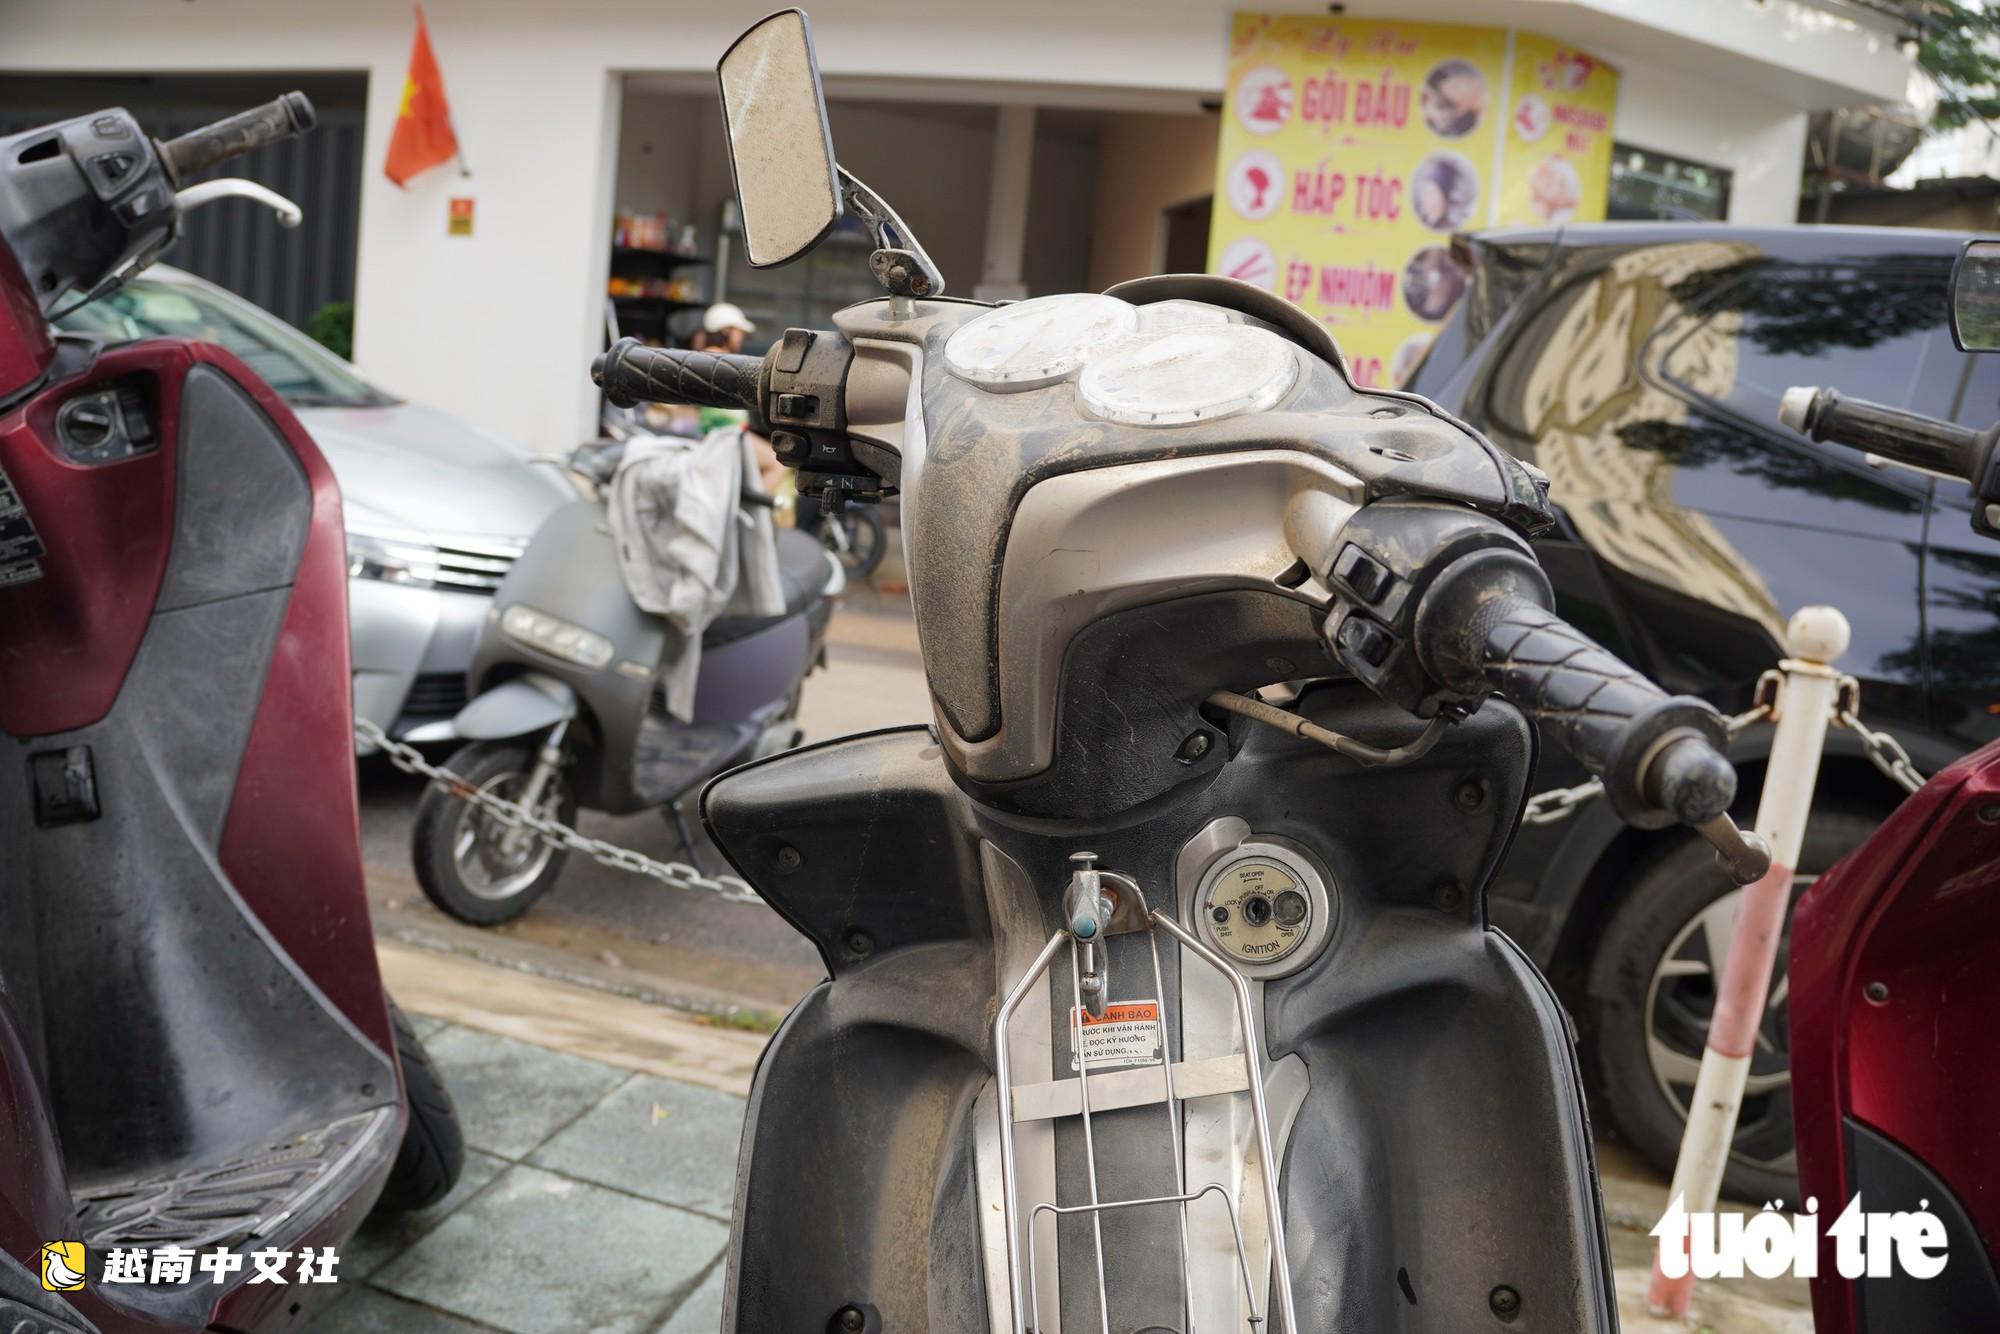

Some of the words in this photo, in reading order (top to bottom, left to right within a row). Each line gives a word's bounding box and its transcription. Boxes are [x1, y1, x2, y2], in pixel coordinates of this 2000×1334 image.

[1355, 165, 1402, 223] TÓC
[1241, 940, 1281, 954] IGNITION
[1102, 1026, 1116, 1034] KHI
